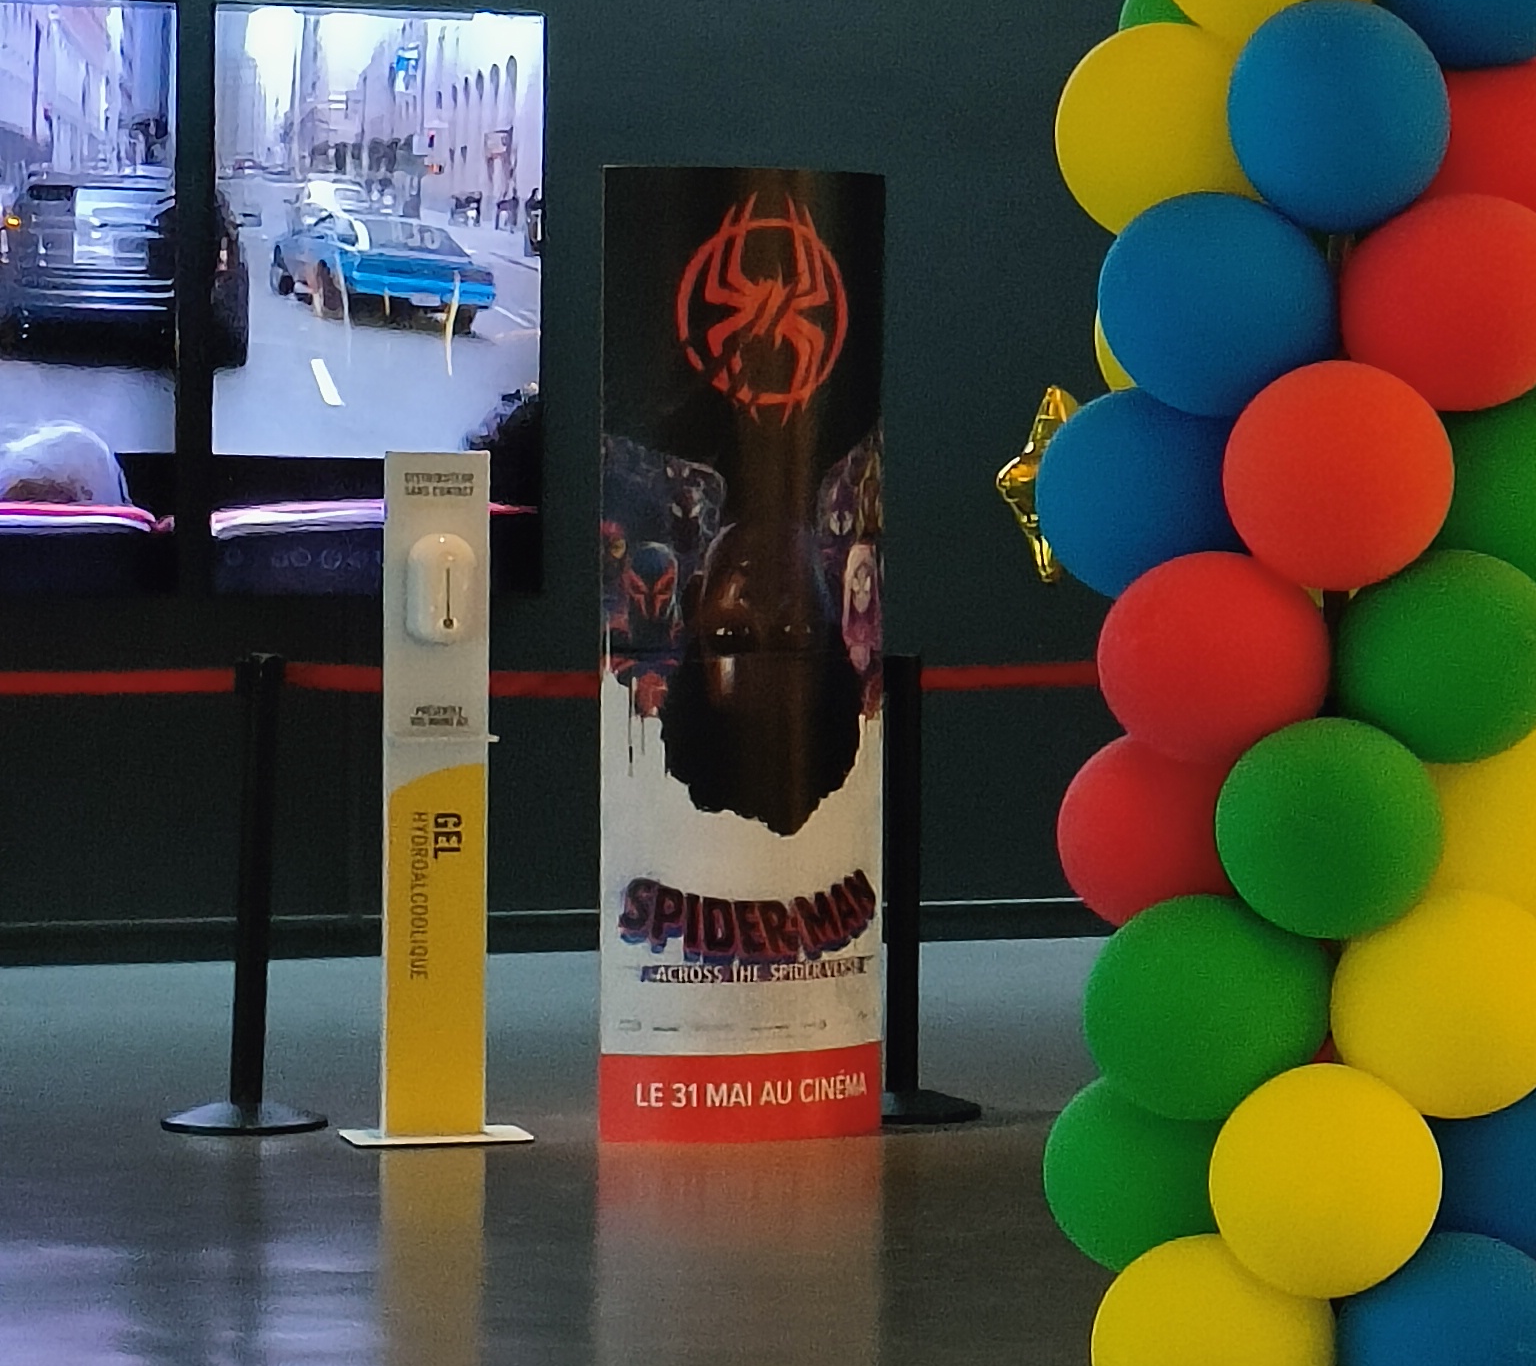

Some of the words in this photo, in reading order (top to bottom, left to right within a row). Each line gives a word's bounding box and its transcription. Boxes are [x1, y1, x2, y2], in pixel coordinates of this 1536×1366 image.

[433, 812, 463, 860] GEL
[409, 811, 429, 980] HYDROALCOOLIQUE
[655, 964, 723, 984] ACROSS
[731, 965, 760, 983] THE
[635, 1082, 664, 1108] LE
[671, 1082, 698, 1108] 31
[705, 1081, 752, 1107] MAI
[759, 1079, 792, 1105] AU
[800, 1068, 868, 1103] CINÉMA
